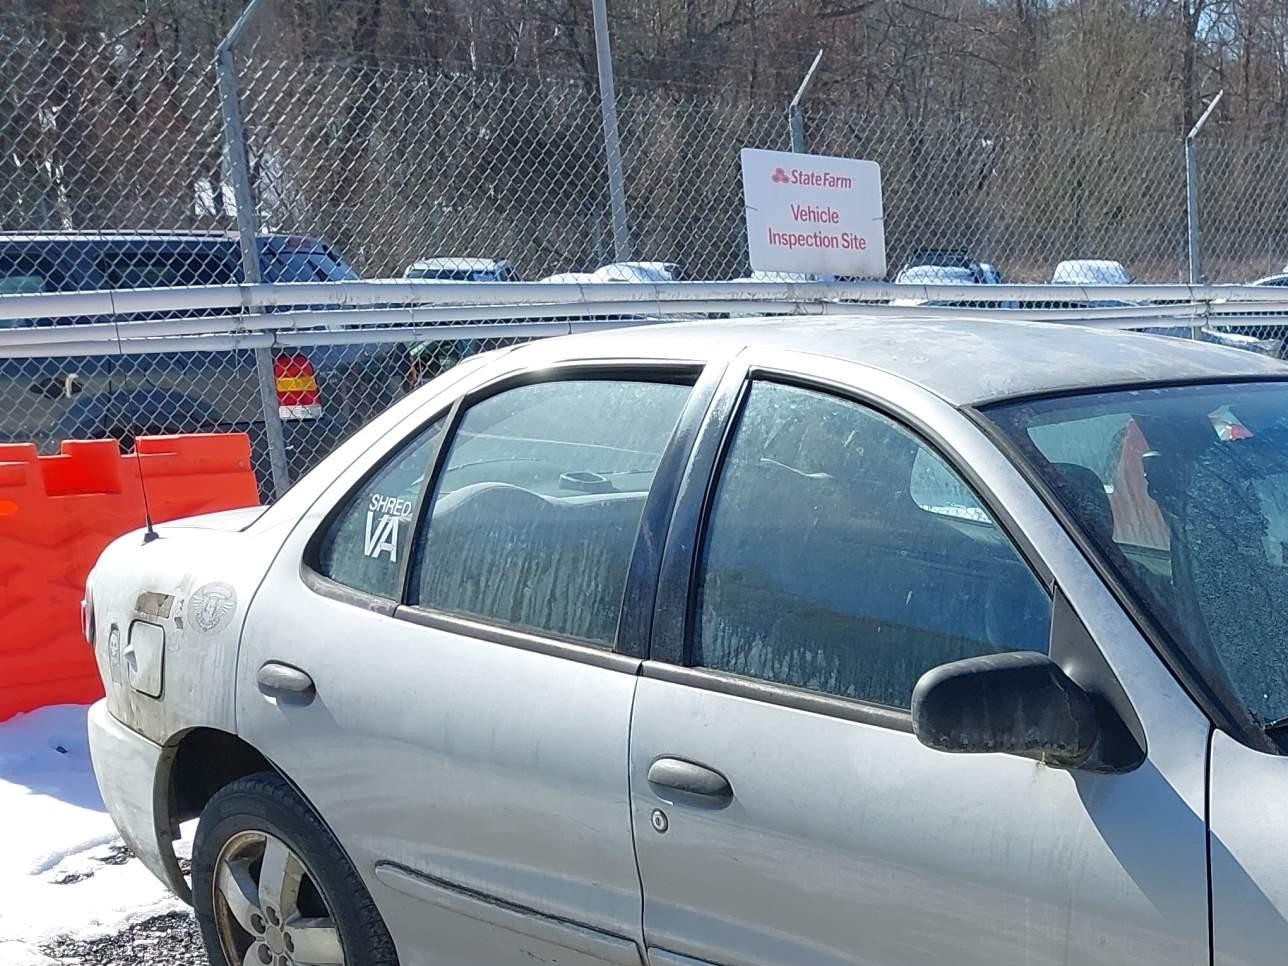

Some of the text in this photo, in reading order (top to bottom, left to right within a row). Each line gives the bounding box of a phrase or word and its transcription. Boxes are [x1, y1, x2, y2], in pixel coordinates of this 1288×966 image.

[790, 203, 840, 224] Vehicle
[768, 228, 867, 250] Inspection Site
[369, 493, 412, 516] SHRED
[364, 510, 399, 562] VA
